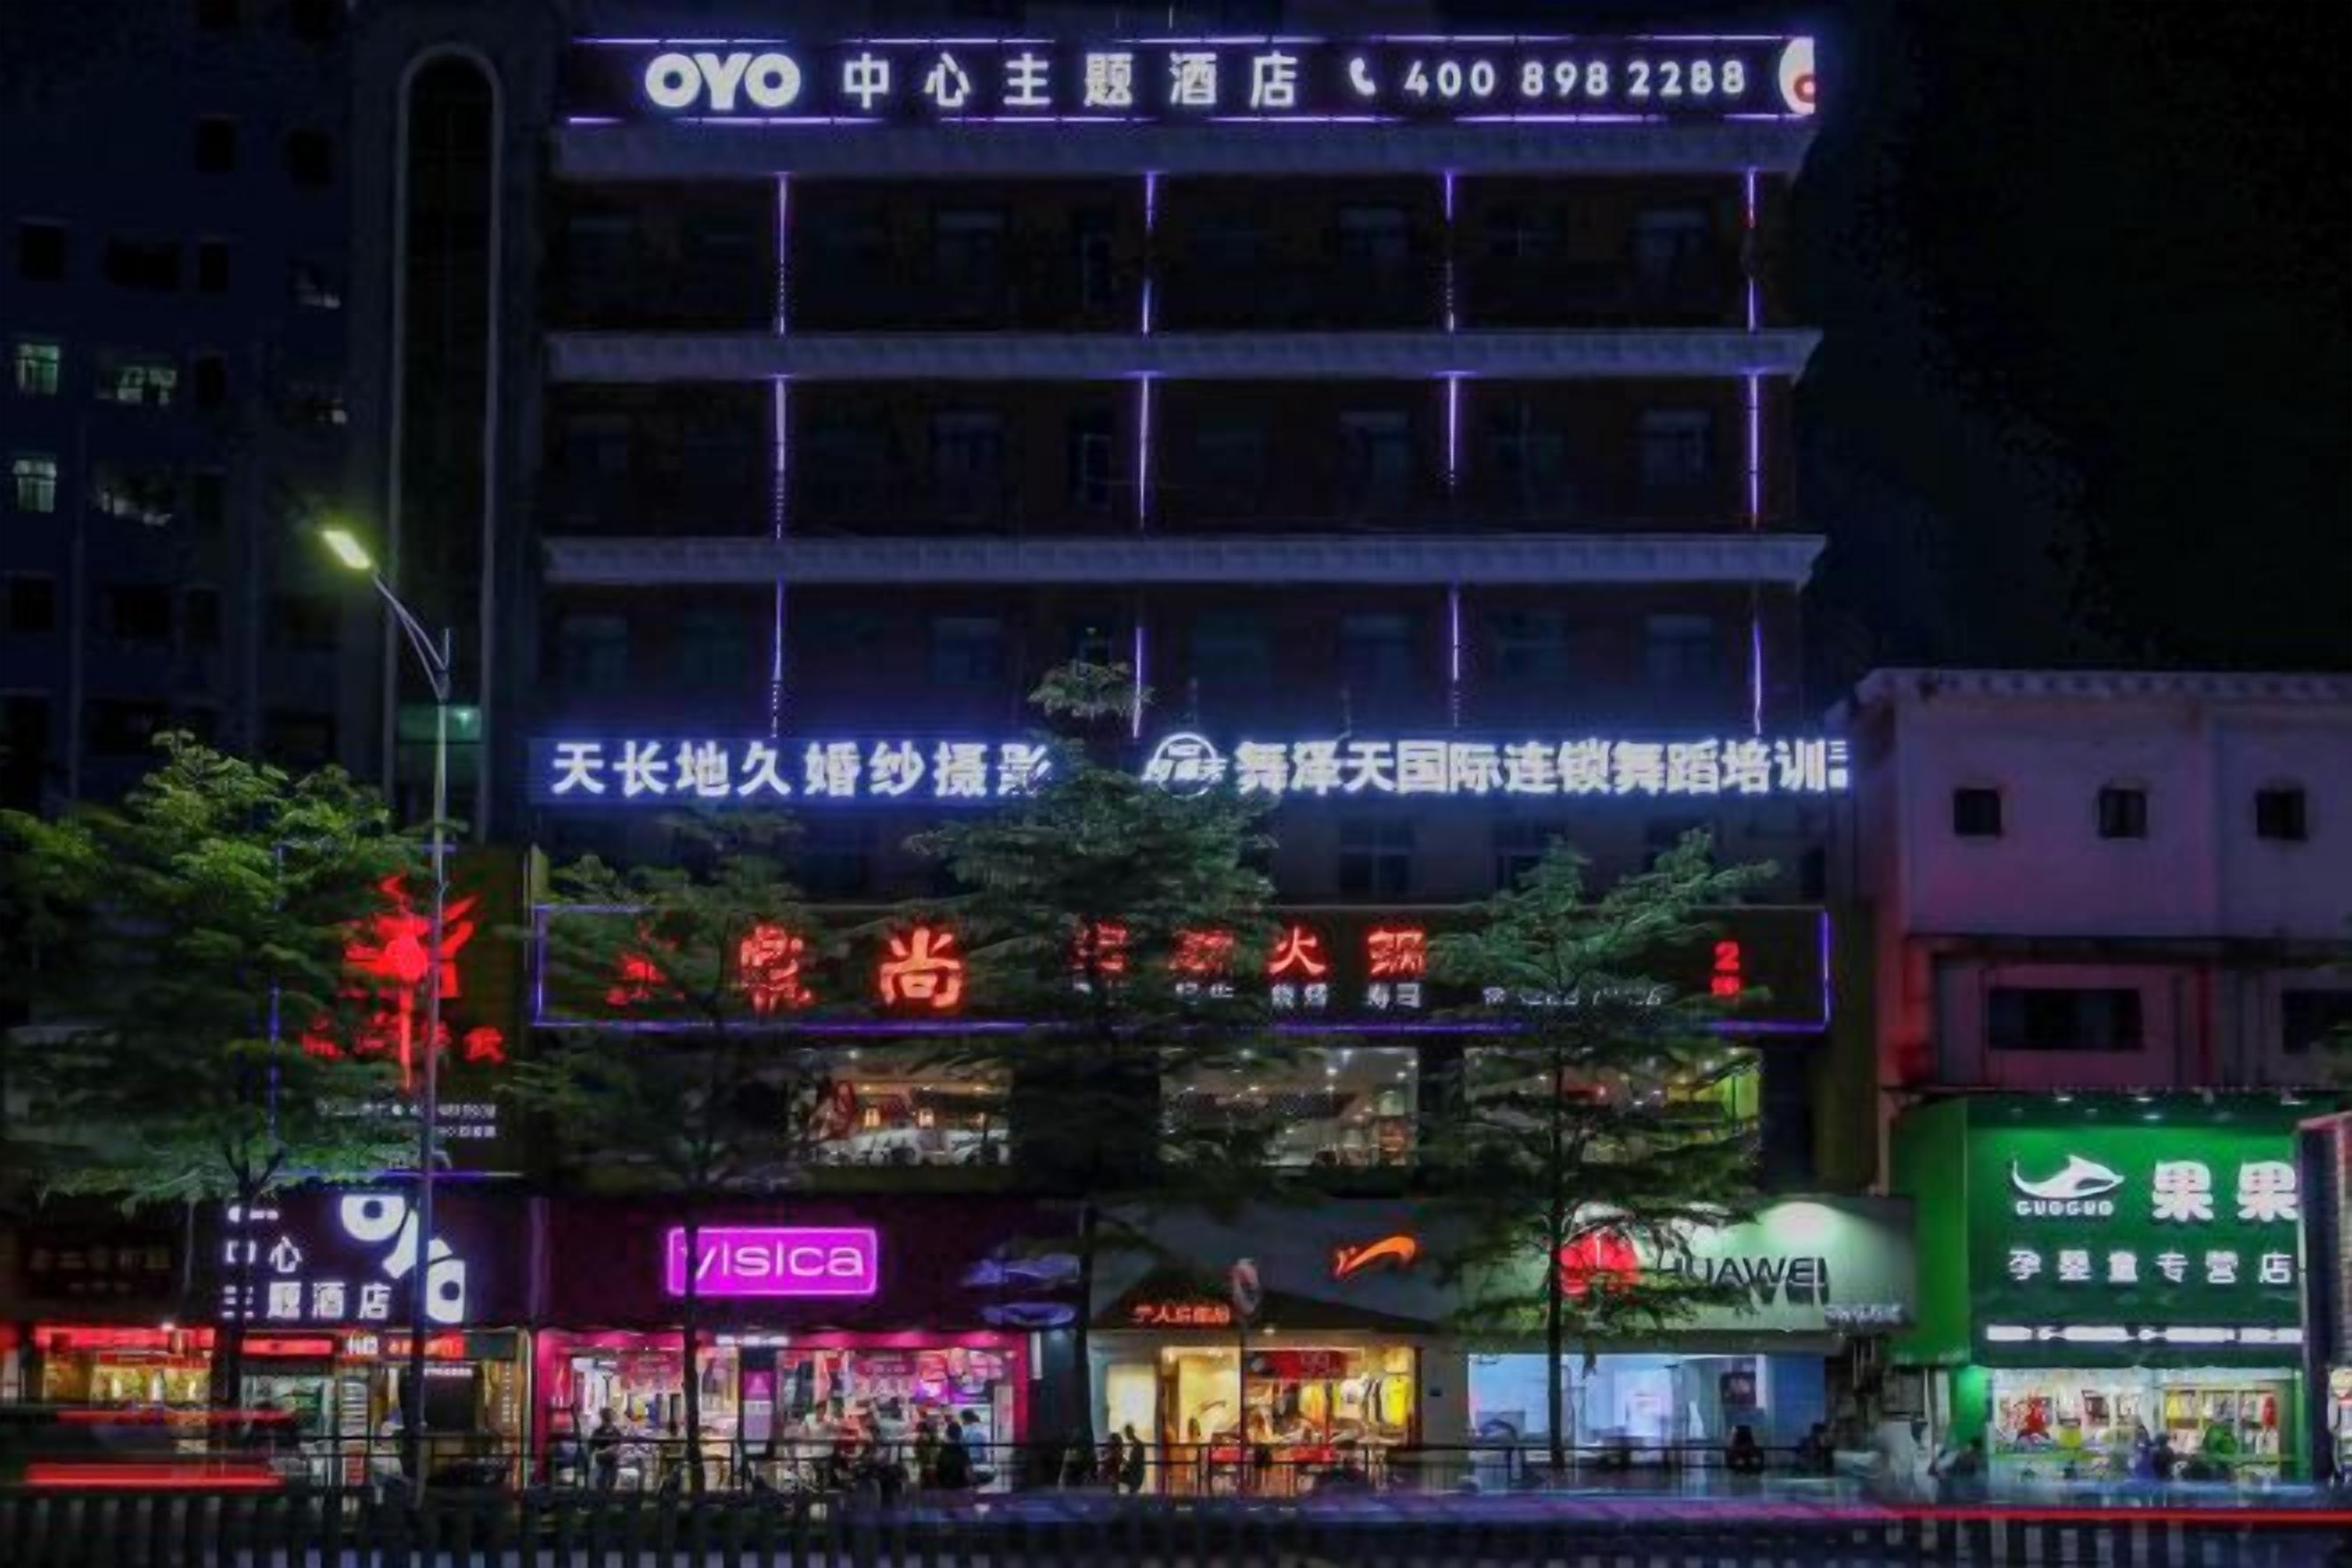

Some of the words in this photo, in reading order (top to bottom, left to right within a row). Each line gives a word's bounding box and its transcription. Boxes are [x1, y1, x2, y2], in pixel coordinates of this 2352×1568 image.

[644, 52, 801, 109] OYO
[843, 51, 1298, 110] 中心主题酒店
[1404, 60, 1495, 96] 400
[1521, 60, 1609, 96] 898
[1628, 60, 1745, 96] 2288
[551, 739, 1051, 798] 天长地久婚纱摄影
[2014, 1200, 2115, 1217] GUOGUO
[2152, 1160, 2299, 1221] 果果
